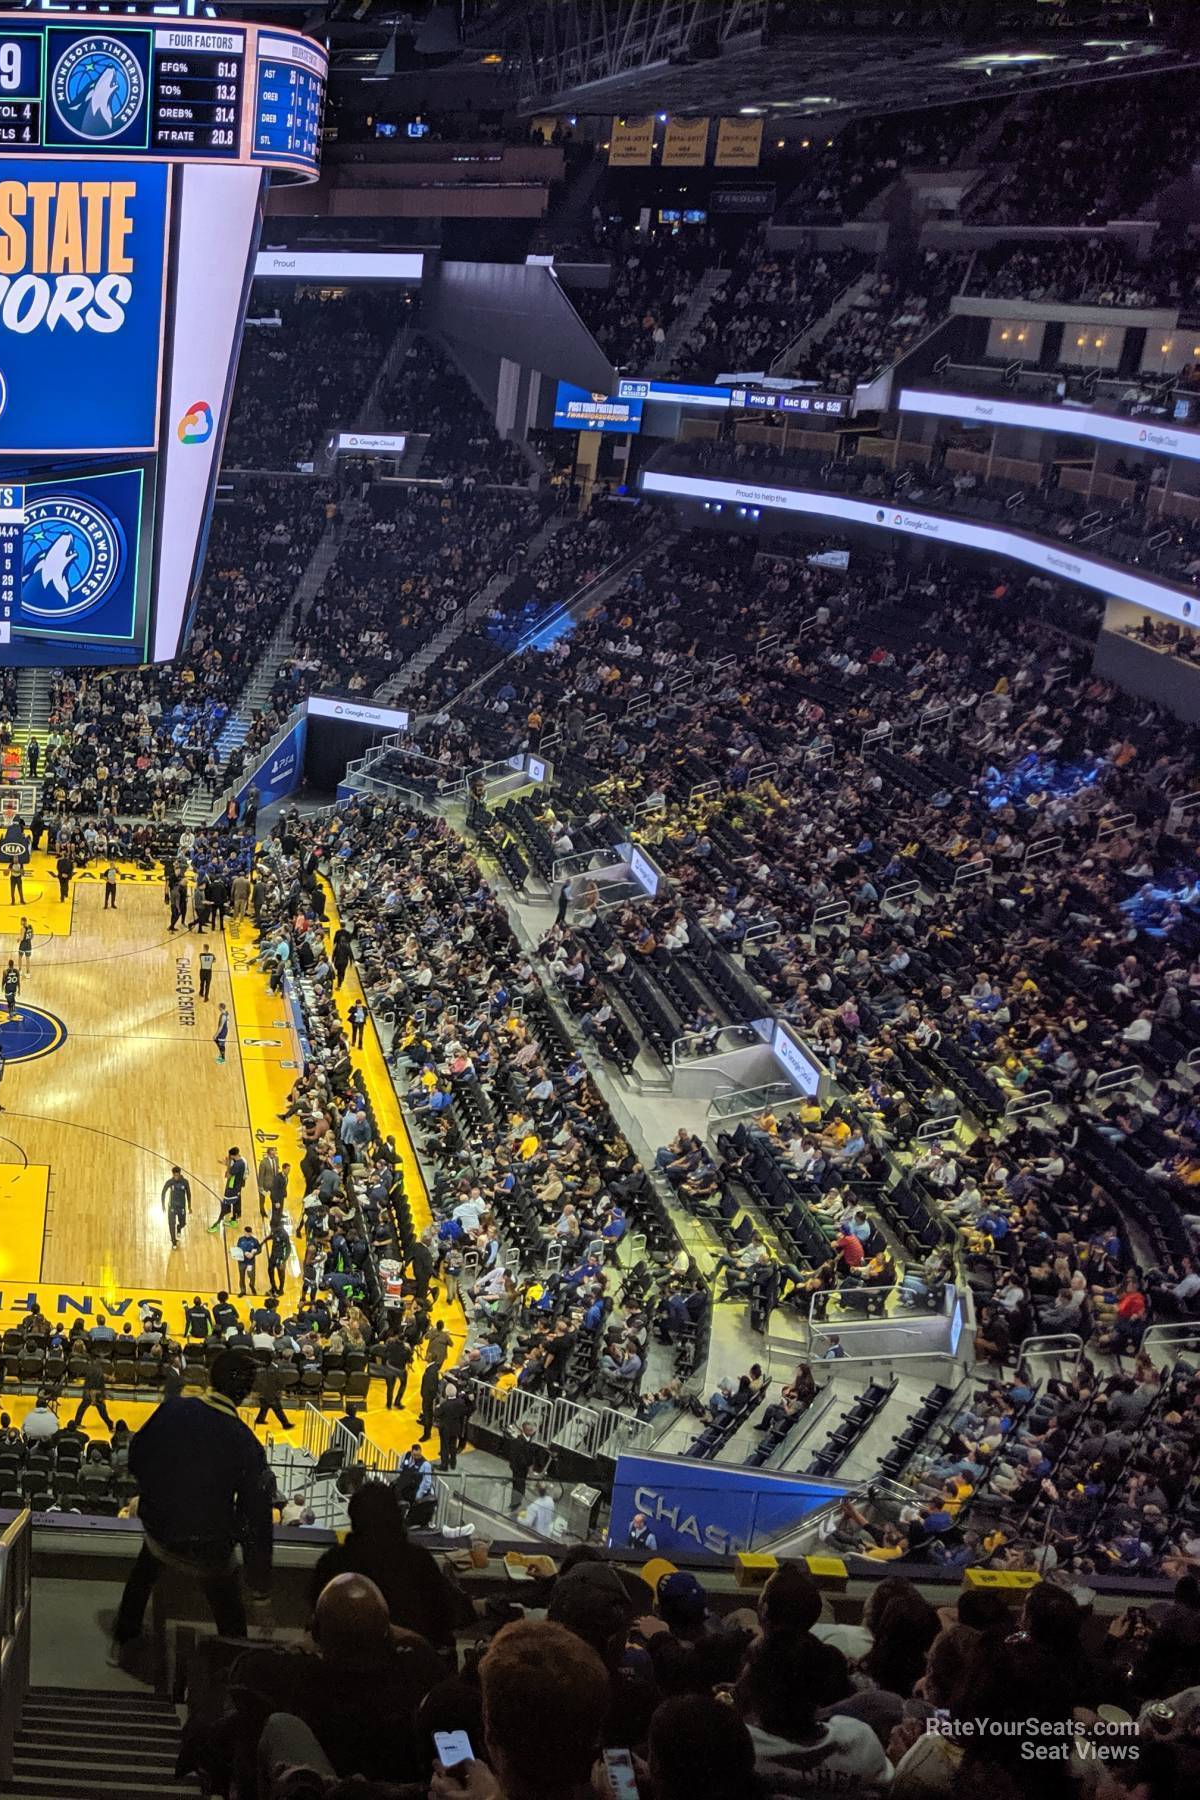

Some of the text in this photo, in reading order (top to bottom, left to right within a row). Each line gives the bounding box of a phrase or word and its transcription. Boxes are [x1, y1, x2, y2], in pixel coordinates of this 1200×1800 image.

[169, 34, 233, 49] FOUR FACTORS
[161, 62, 237, 77] EFG% 61.8
[57, 42, 139, 122] MINNESOTA TIMBERWOLVES
[160, 85, 236, 100] TO% 13.2
[22, 104, 31, 119] 4
[159, 107, 235, 122] OREB% 31.4
[22, 126, 31, 141] 4
[158, 129, 233, 144] FT RATE 20.8
[273, 259, 295, 268] Proud
[736, 489, 753, 499] Proud
[761, 492, 775, 502] help
[55, 506, 108, 595] TIMBERWOLVES
[1, 591, 13, 601] 42
[345, 709, 364, 719] Google
[5, 845, 22, 853] KIA
[7, 976, 17, 984] 20
[176, 958, 195, 1027] CHASE CENTER
